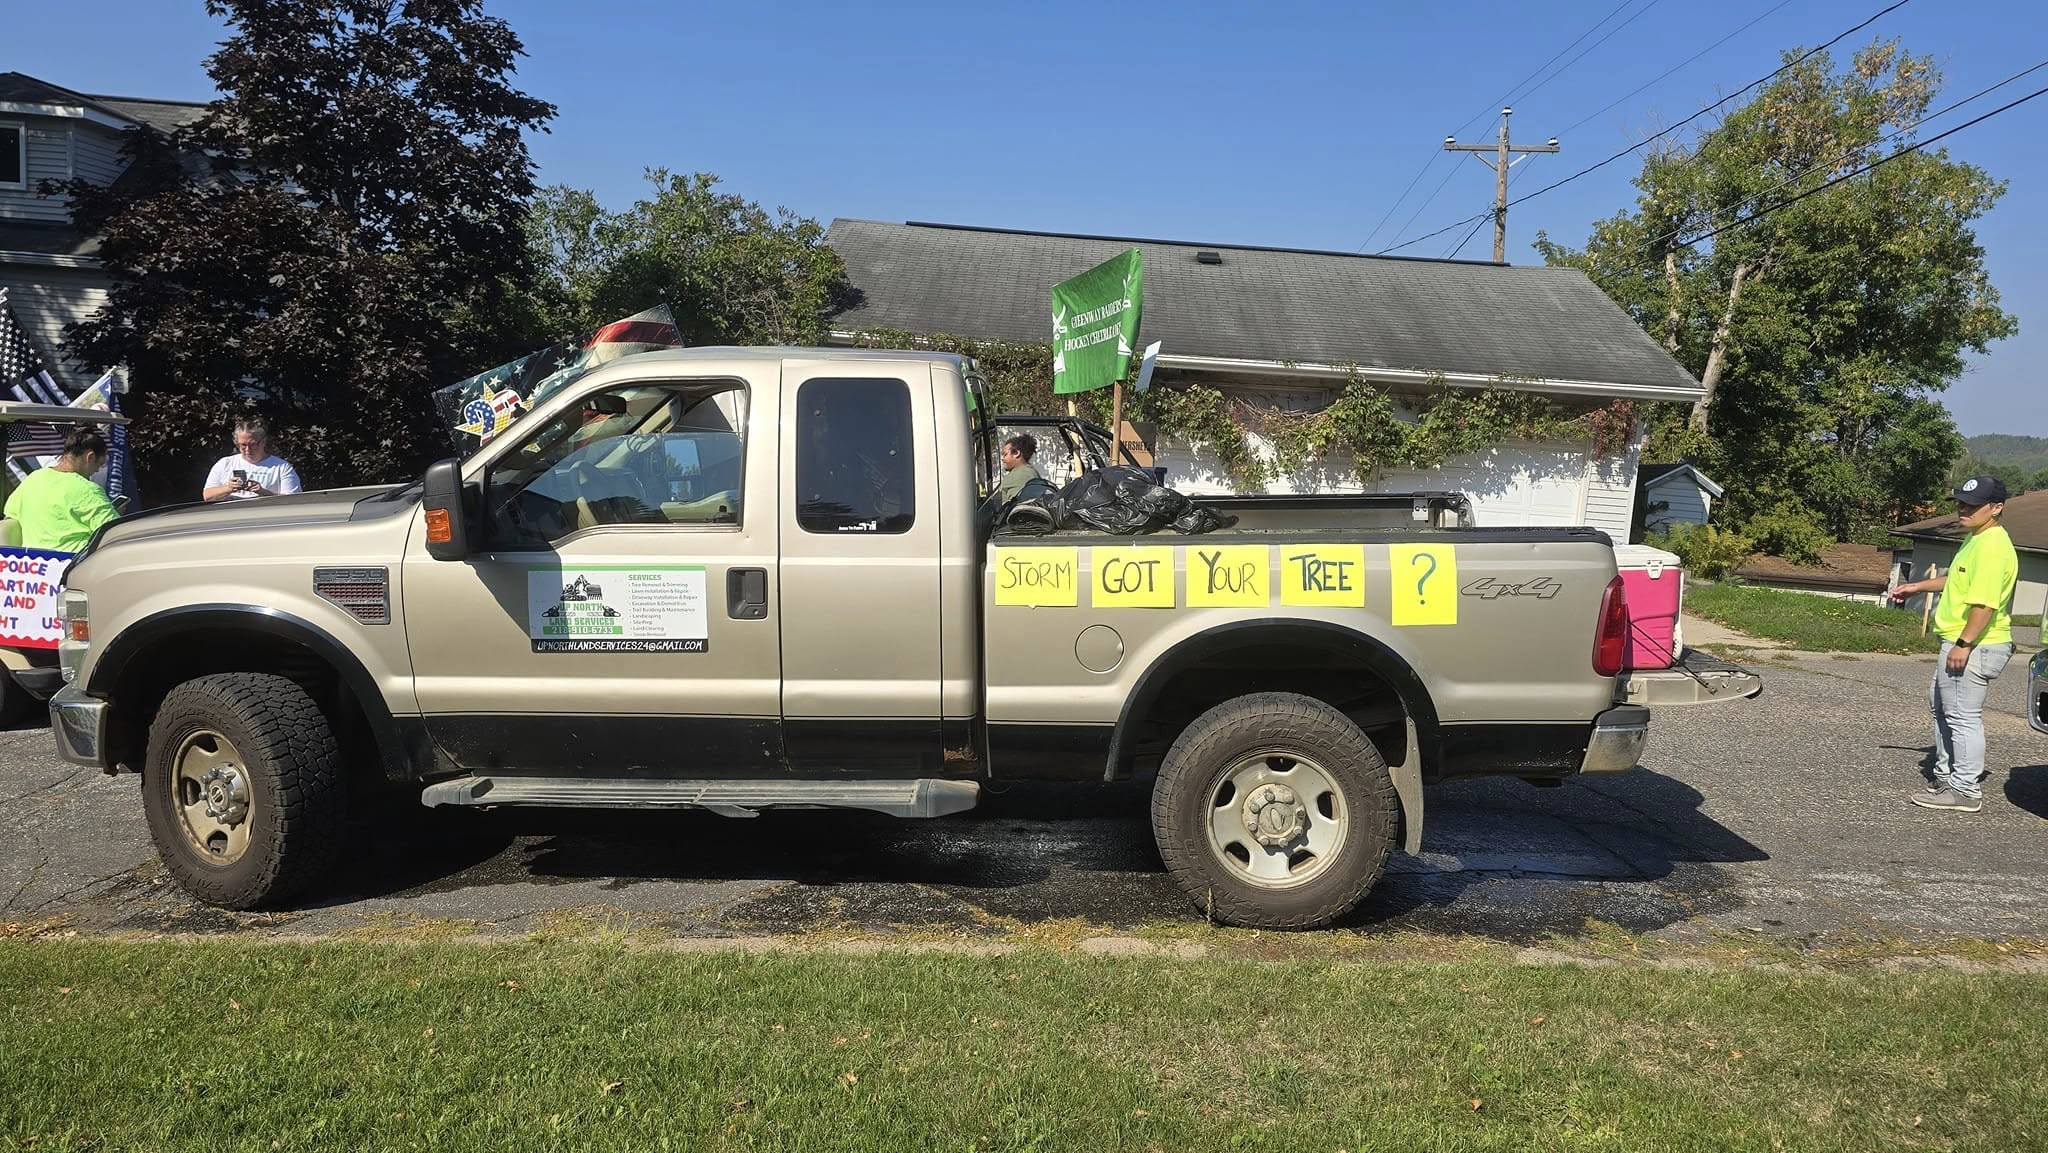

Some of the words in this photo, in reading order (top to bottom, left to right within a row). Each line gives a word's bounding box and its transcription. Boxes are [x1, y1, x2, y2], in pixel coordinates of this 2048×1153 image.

[1071, 308, 1101, 329] GREENWAY
[1064, 333, 1090, 351] HOCKEY
[0, 560, 48, 576] POLICE
[1001, 556, 1071, 590] STORM
[1101, 557, 1161, 594] GOT
[1198, 550, 1260, 597] YOUR
[1289, 553, 1355, 593] TREE
[1411, 552, 1437, 605] ?
[4, 595, 36, 609] AND
[559, 602, 571, 612] UP
[573, 602, 603, 612] NORTH
[549, 617, 573, 626] LAND
[574, 617, 615, 626] SERVICES
